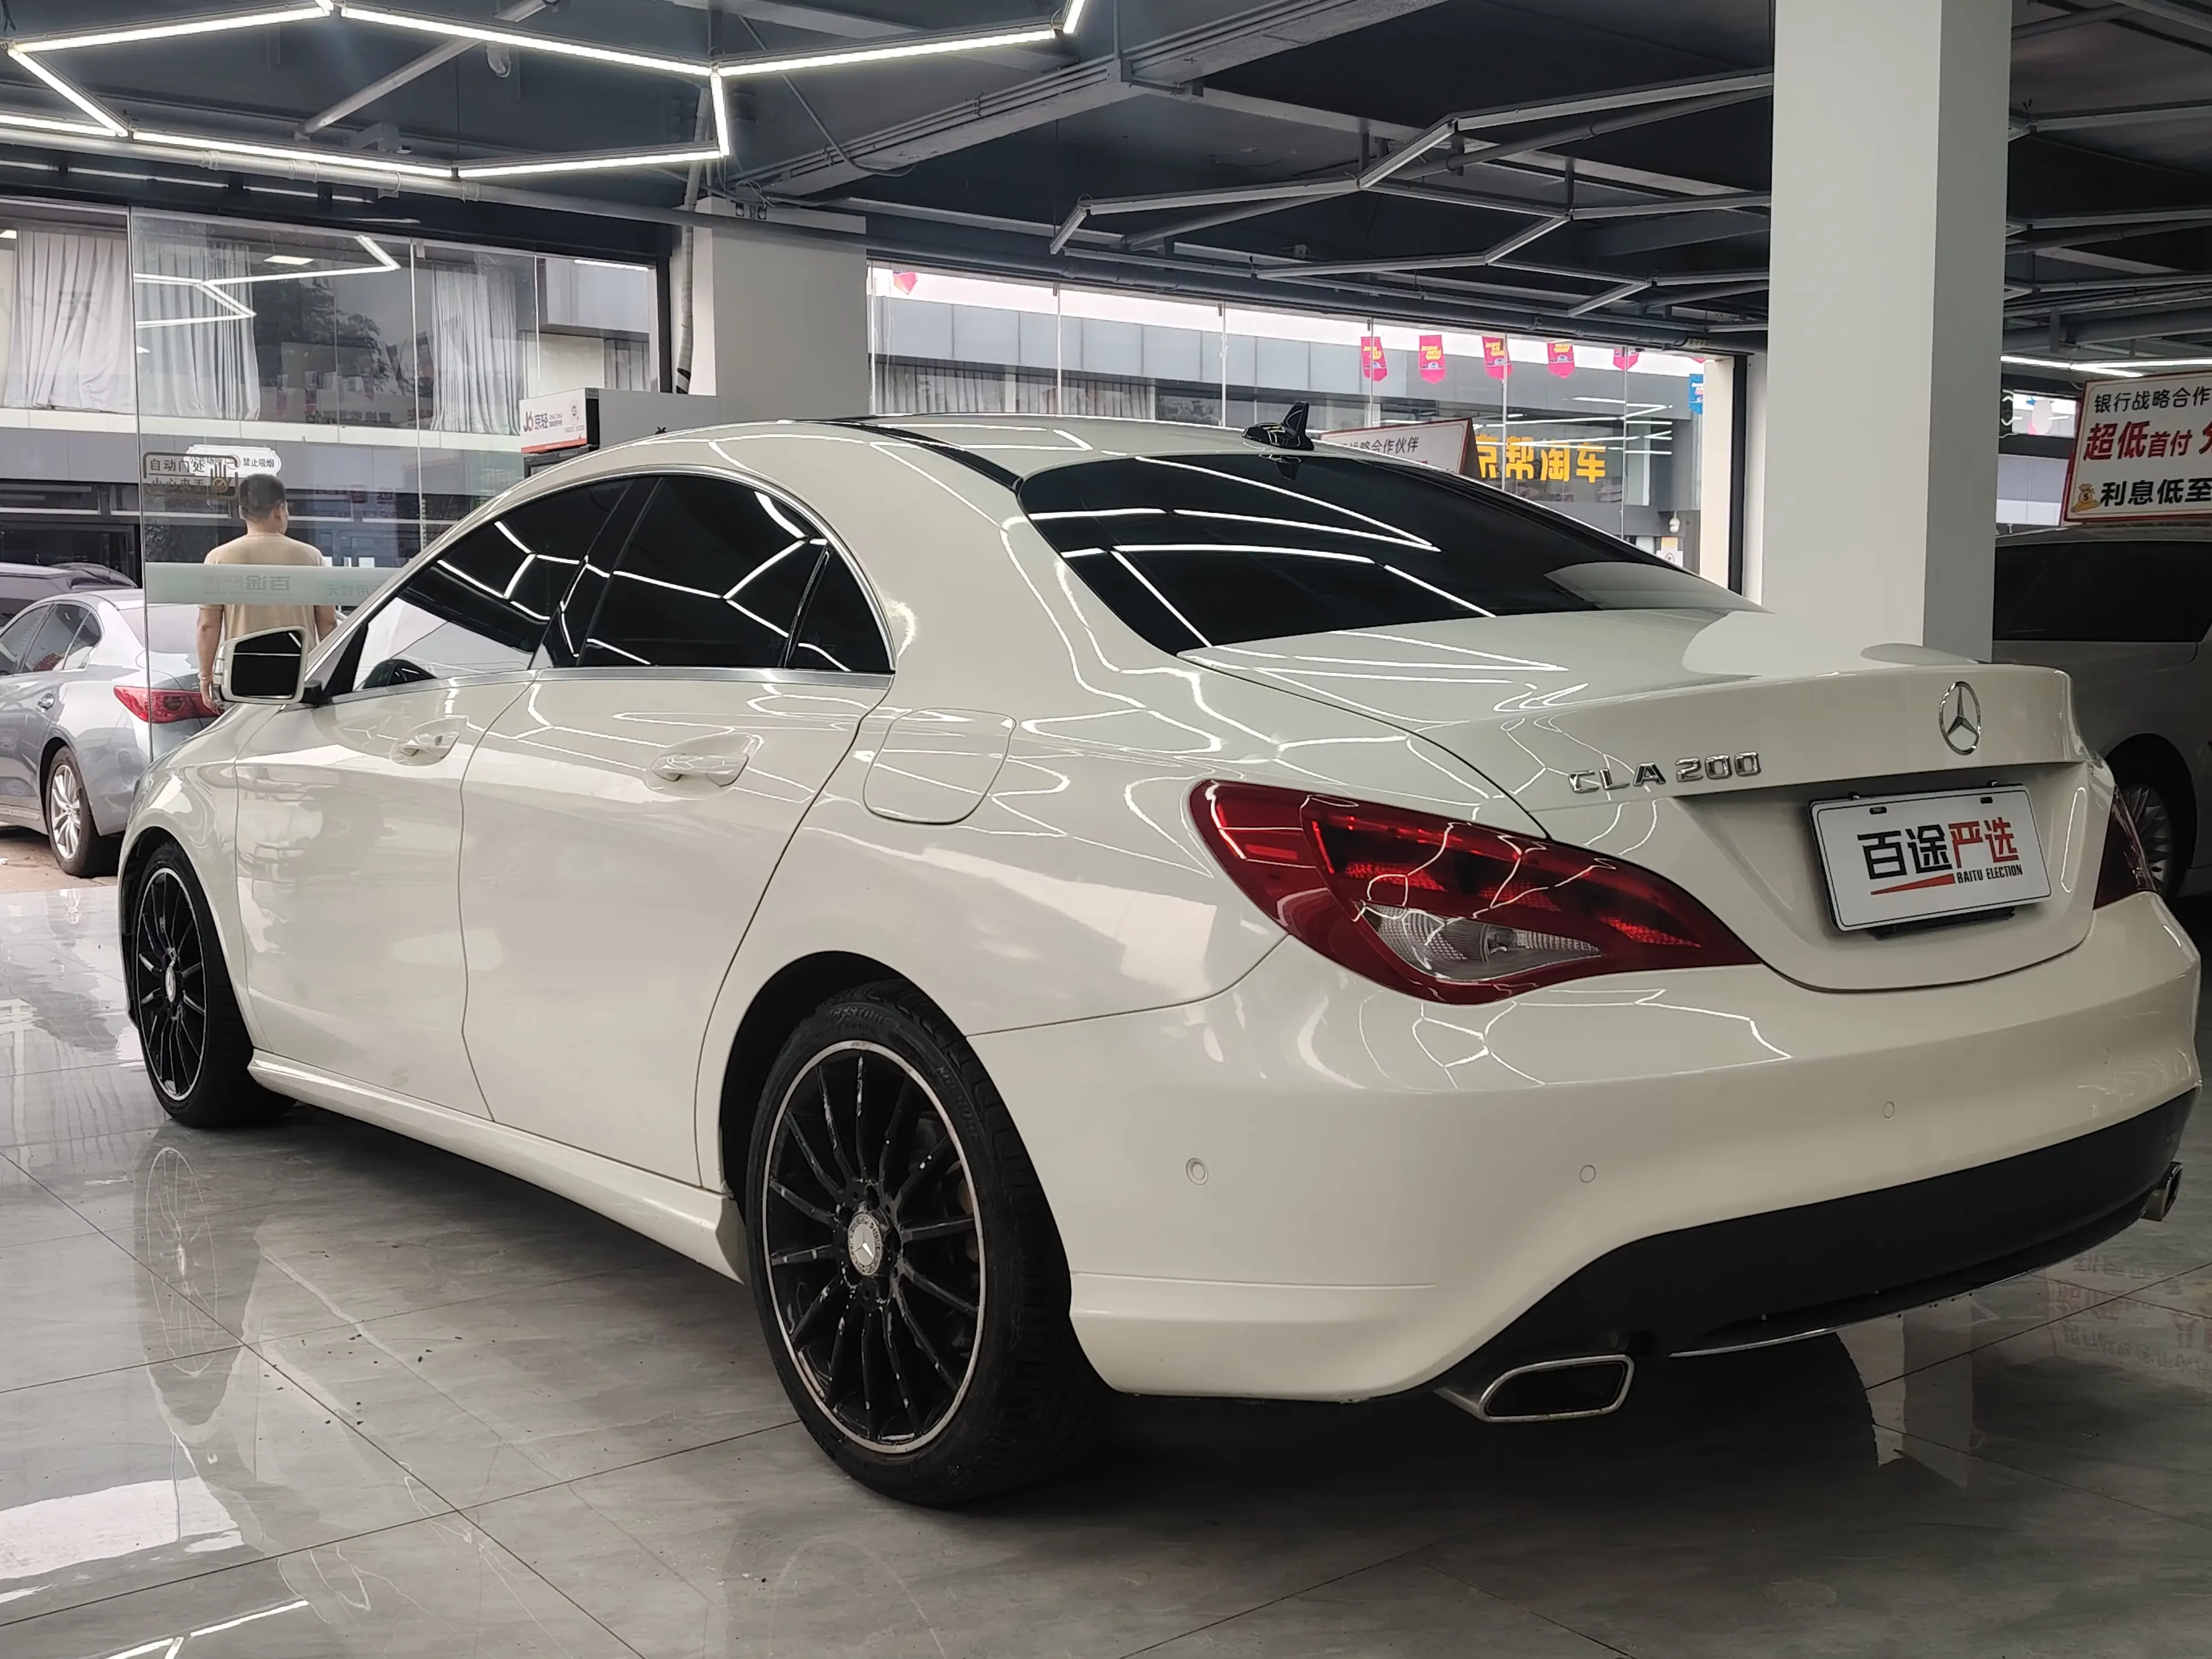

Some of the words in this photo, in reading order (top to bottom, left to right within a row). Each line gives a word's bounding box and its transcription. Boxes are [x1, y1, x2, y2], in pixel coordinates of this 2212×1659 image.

[2094, 385, 2211, 413] 银行战略合作
[1343, 436, 1420, 455] 略合作伙伴
[2083, 420, 2193, 461] 超低首付
[150, 458, 205, 472] 自动门处
[243, 458, 274, 468] 禁止吸烟
[1475, 434, 1606, 484] 京帮淘车
[2100, 477, 2212, 507] 利息低至
[1568, 761, 1666, 793] CLA
[1675, 752, 1762, 782] 200
[1856, 817, 2020, 880] 百途严选
[1956, 869, 1984, 884] BAITU
[1986, 864, 2023, 880] ELECTION
